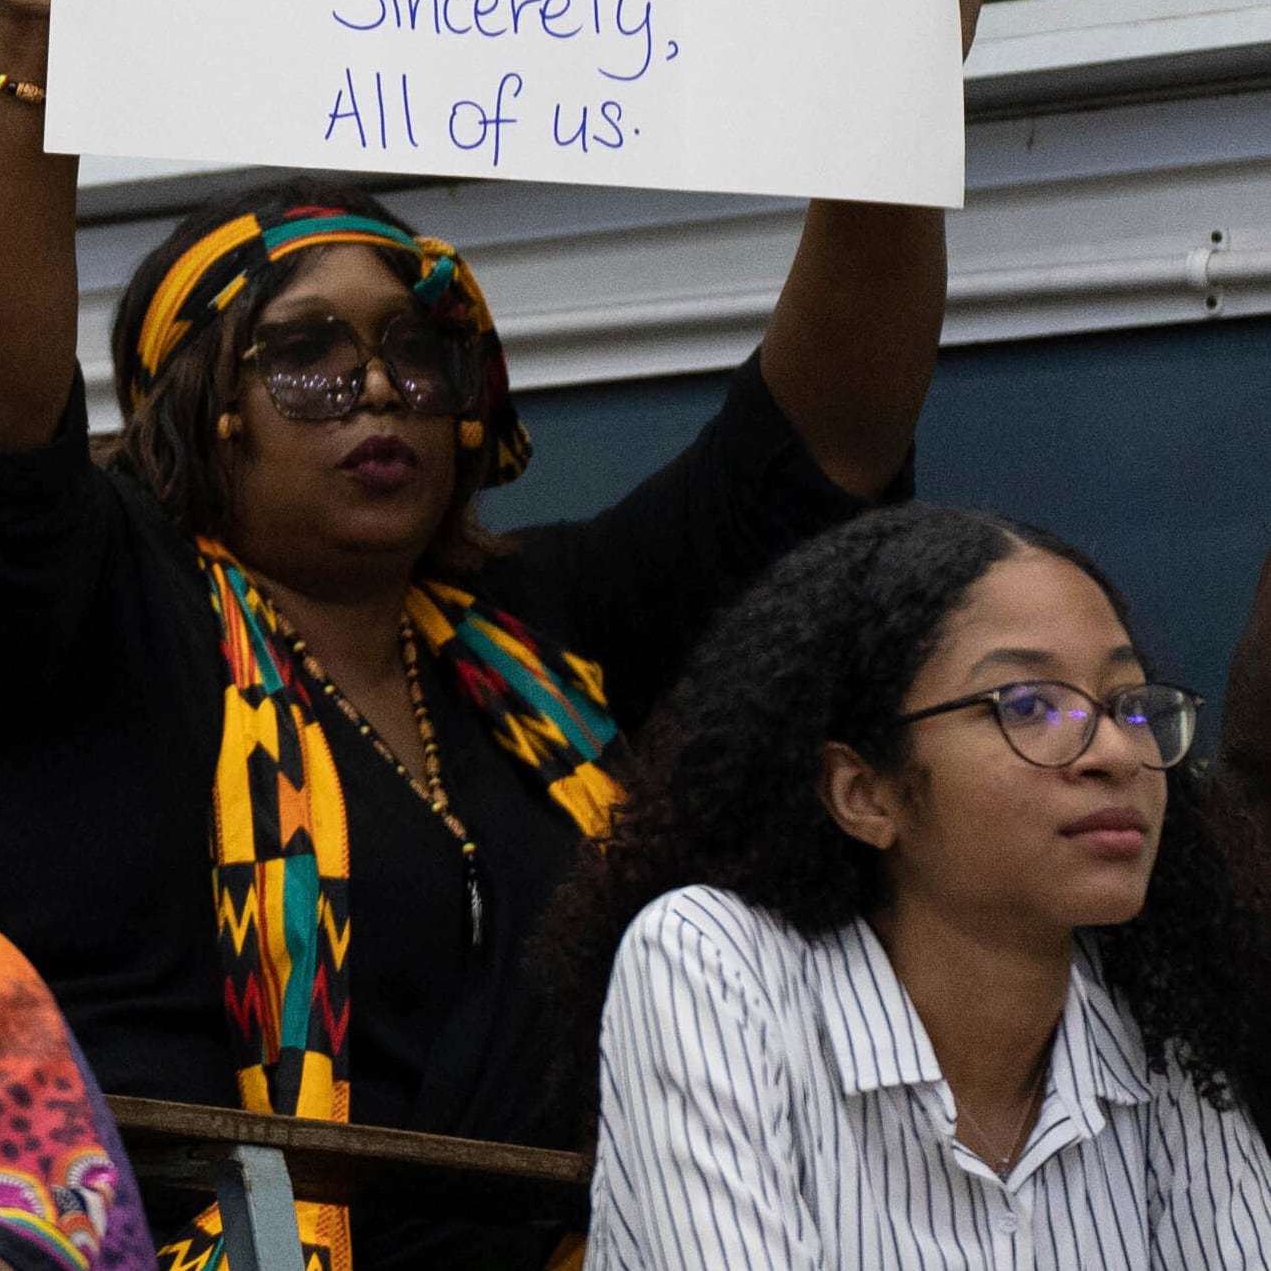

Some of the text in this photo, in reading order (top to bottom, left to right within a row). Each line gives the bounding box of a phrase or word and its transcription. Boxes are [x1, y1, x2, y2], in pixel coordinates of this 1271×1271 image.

[325, 67, 640, 166] All of us.
